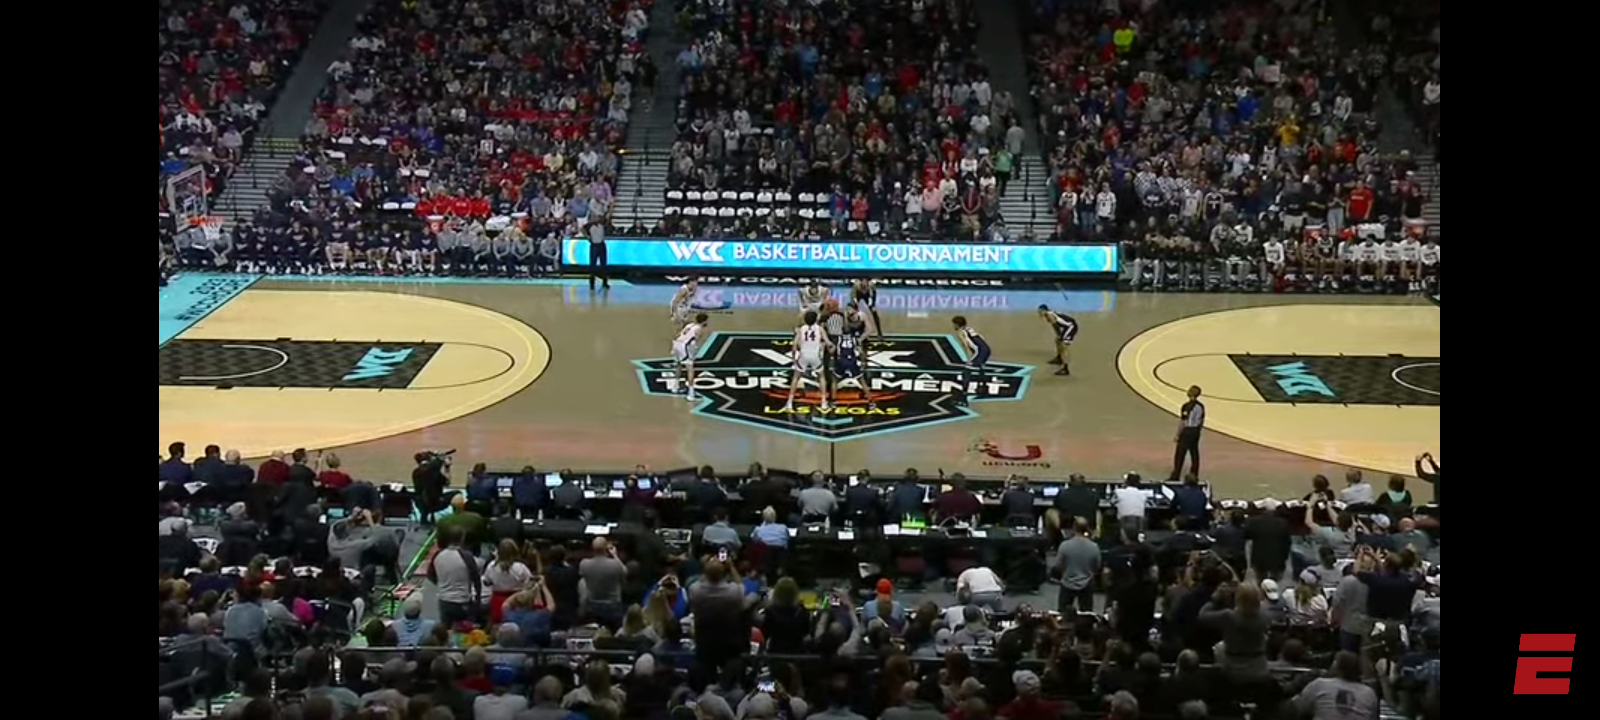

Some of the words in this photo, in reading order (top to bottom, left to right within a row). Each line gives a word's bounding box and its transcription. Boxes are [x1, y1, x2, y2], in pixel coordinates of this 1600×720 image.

[667, 241, 725, 262] WCC
[733, 243, 861, 261] BASKETBALL
[865, 244, 1012, 264] TOURNAMENT
[804, 331, 816, 341] 14
[764, 405, 811, 414] LAS
[815, 406, 902, 415] VEGAS
